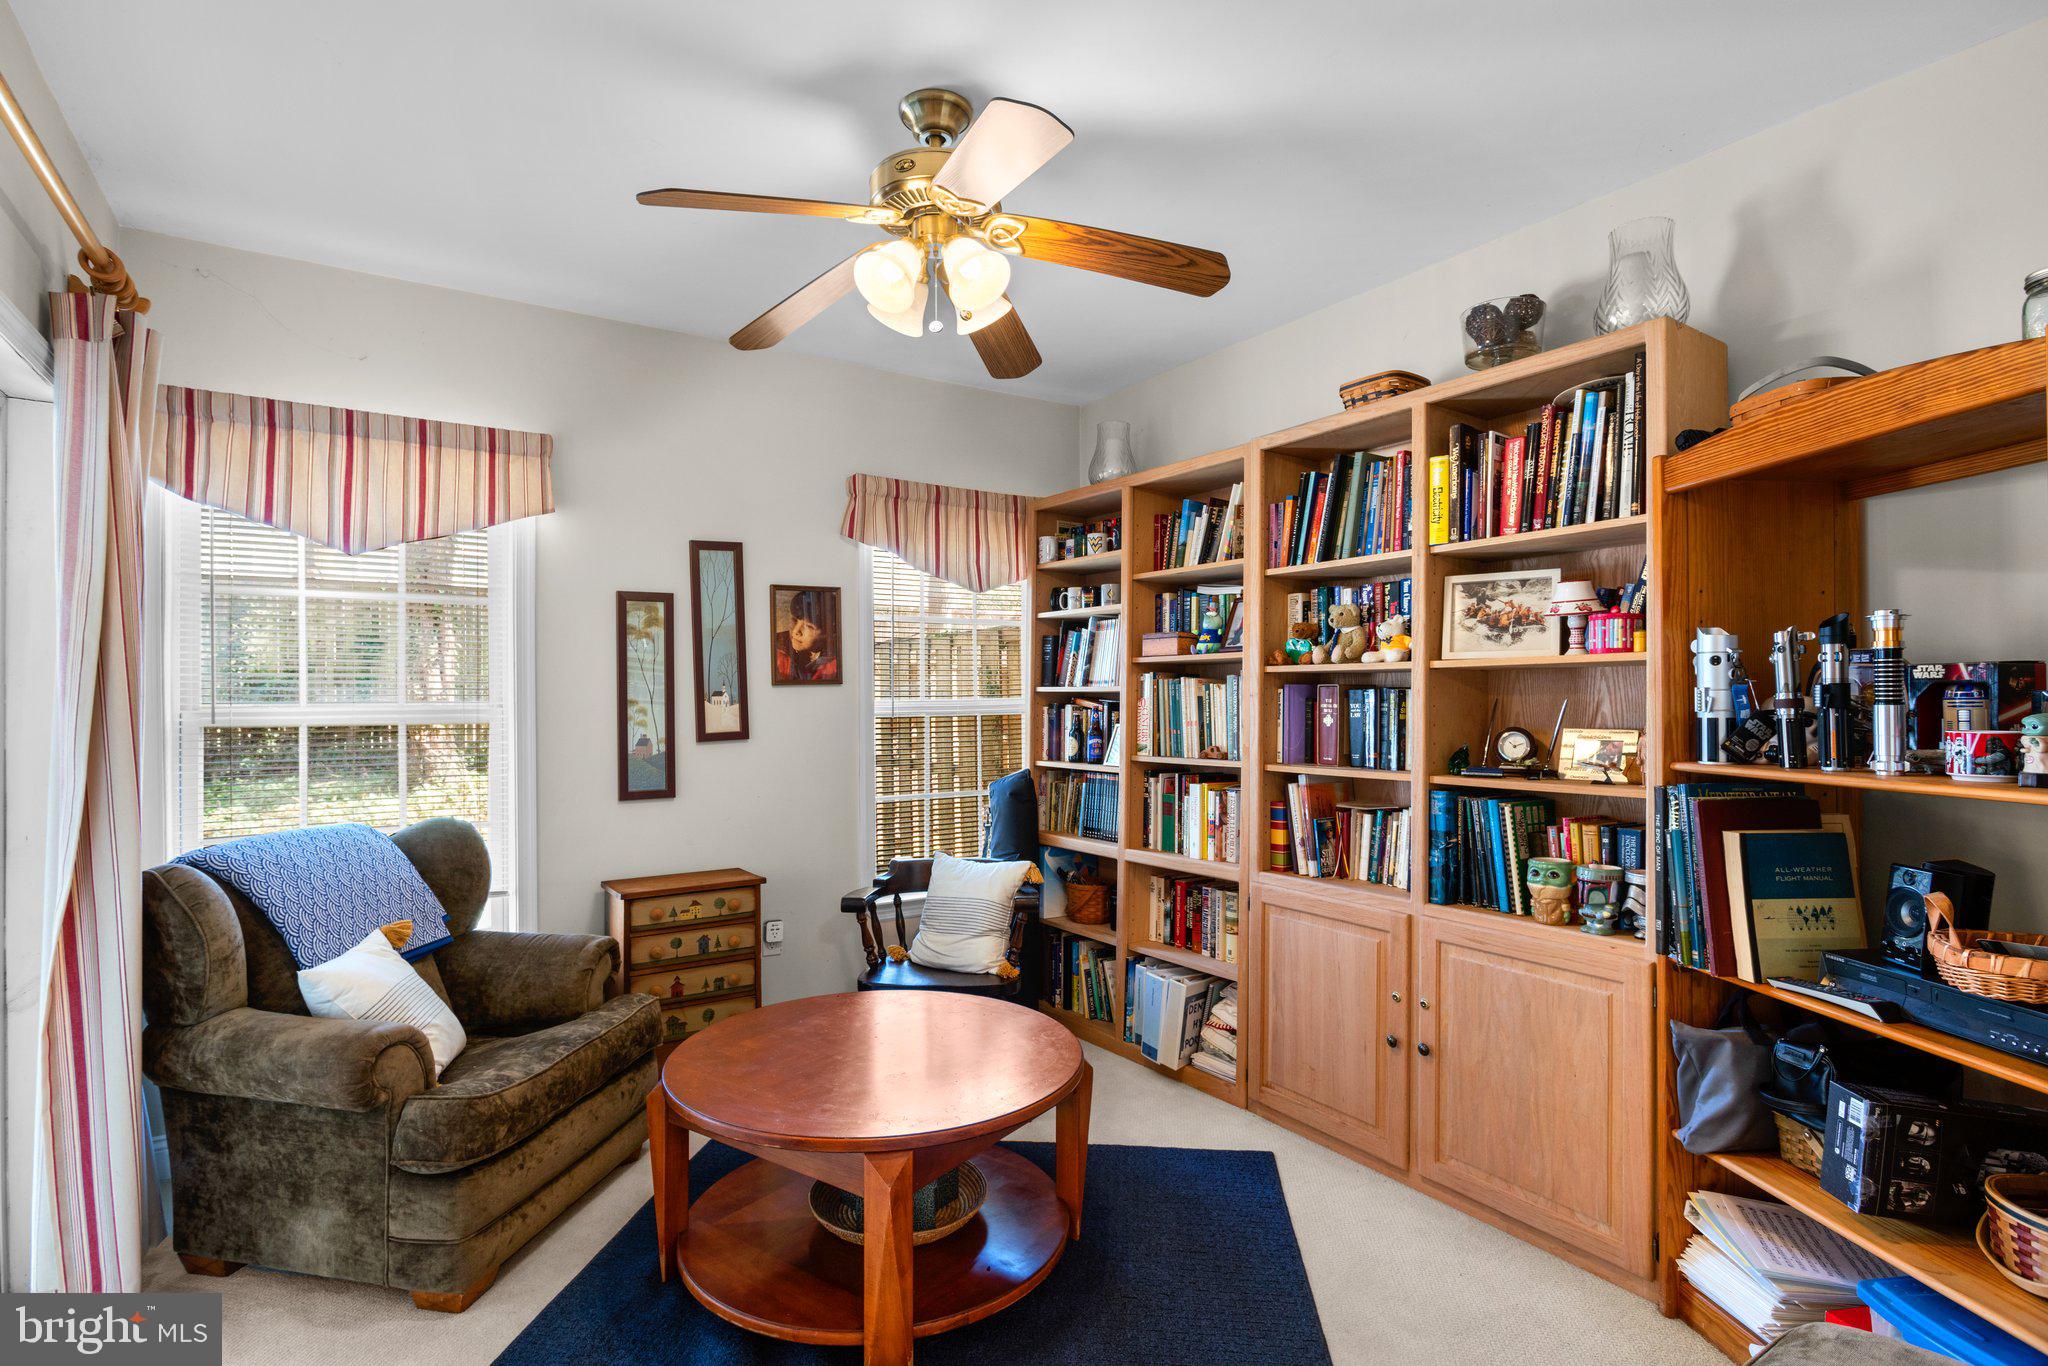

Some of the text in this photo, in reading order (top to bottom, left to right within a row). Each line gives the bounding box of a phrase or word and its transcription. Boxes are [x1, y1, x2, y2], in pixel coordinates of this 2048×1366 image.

[1540, 409, 1549, 447] THROUGH
[1553, 419, 1561, 453] CONTACT
[1431, 487, 1444, 525] Electricity
[1913, 664, 1945, 672] STAR
[1913, 671, 1945, 679] WARS
[1656, 845, 1661, 855] OF
[1825, 953, 1845, 963] SAMSUNG
